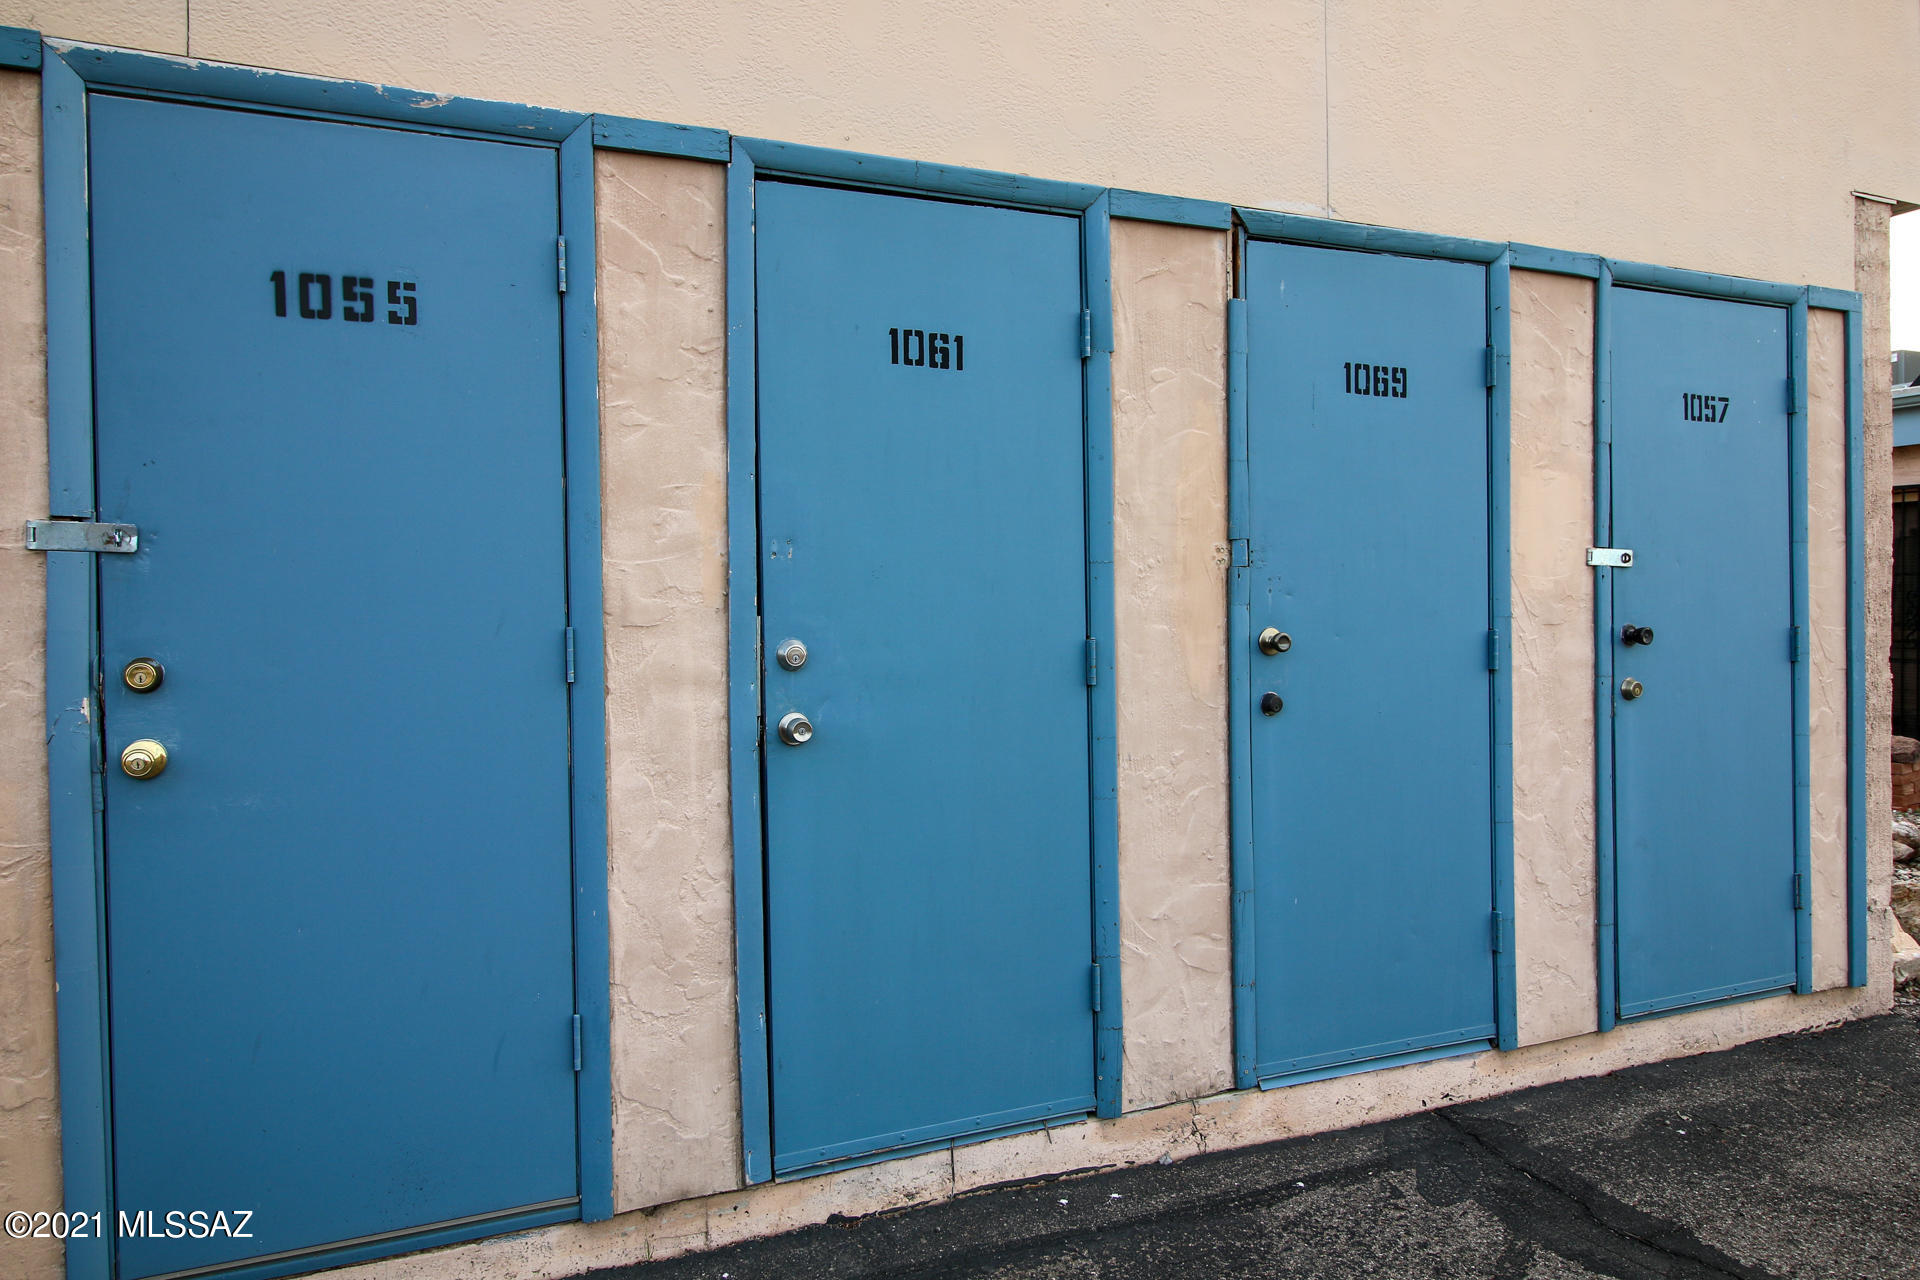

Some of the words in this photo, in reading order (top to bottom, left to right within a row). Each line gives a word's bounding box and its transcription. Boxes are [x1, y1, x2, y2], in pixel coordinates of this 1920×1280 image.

[269, 270, 417, 326] 1055
[888, 327, 964, 371] 1061
[1343, 362, 1407, 399] 1069
[1682, 392, 1730, 423] 1057
